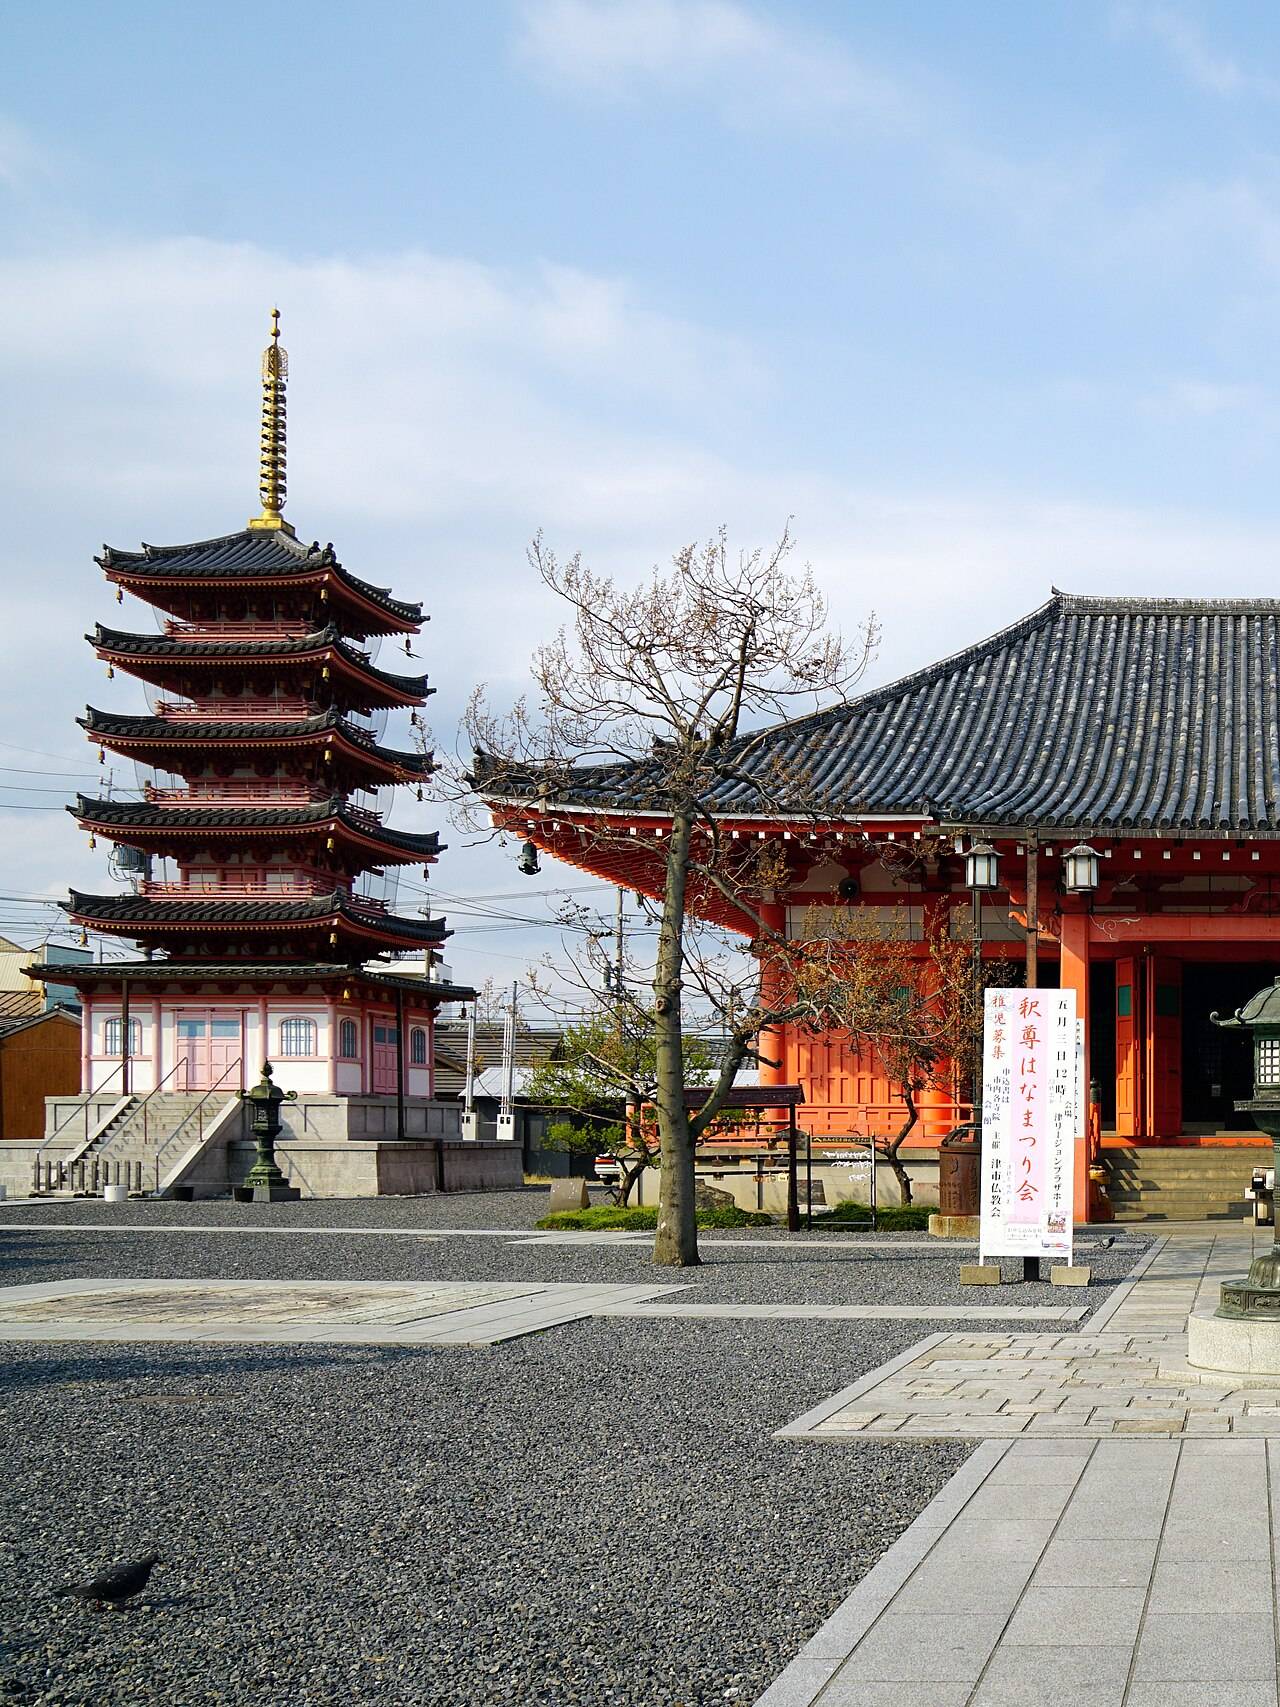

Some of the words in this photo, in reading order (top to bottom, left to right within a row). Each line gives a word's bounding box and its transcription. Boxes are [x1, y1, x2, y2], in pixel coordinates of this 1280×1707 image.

[992, 994, 1006, 1059] 稚児募集
[1016, 996, 1042, 1201] 釈尊はなまつり会
[1065, 1101, 1073, 1118] 会場
[991, 1158, 1002, 1217] 津市仏教会
